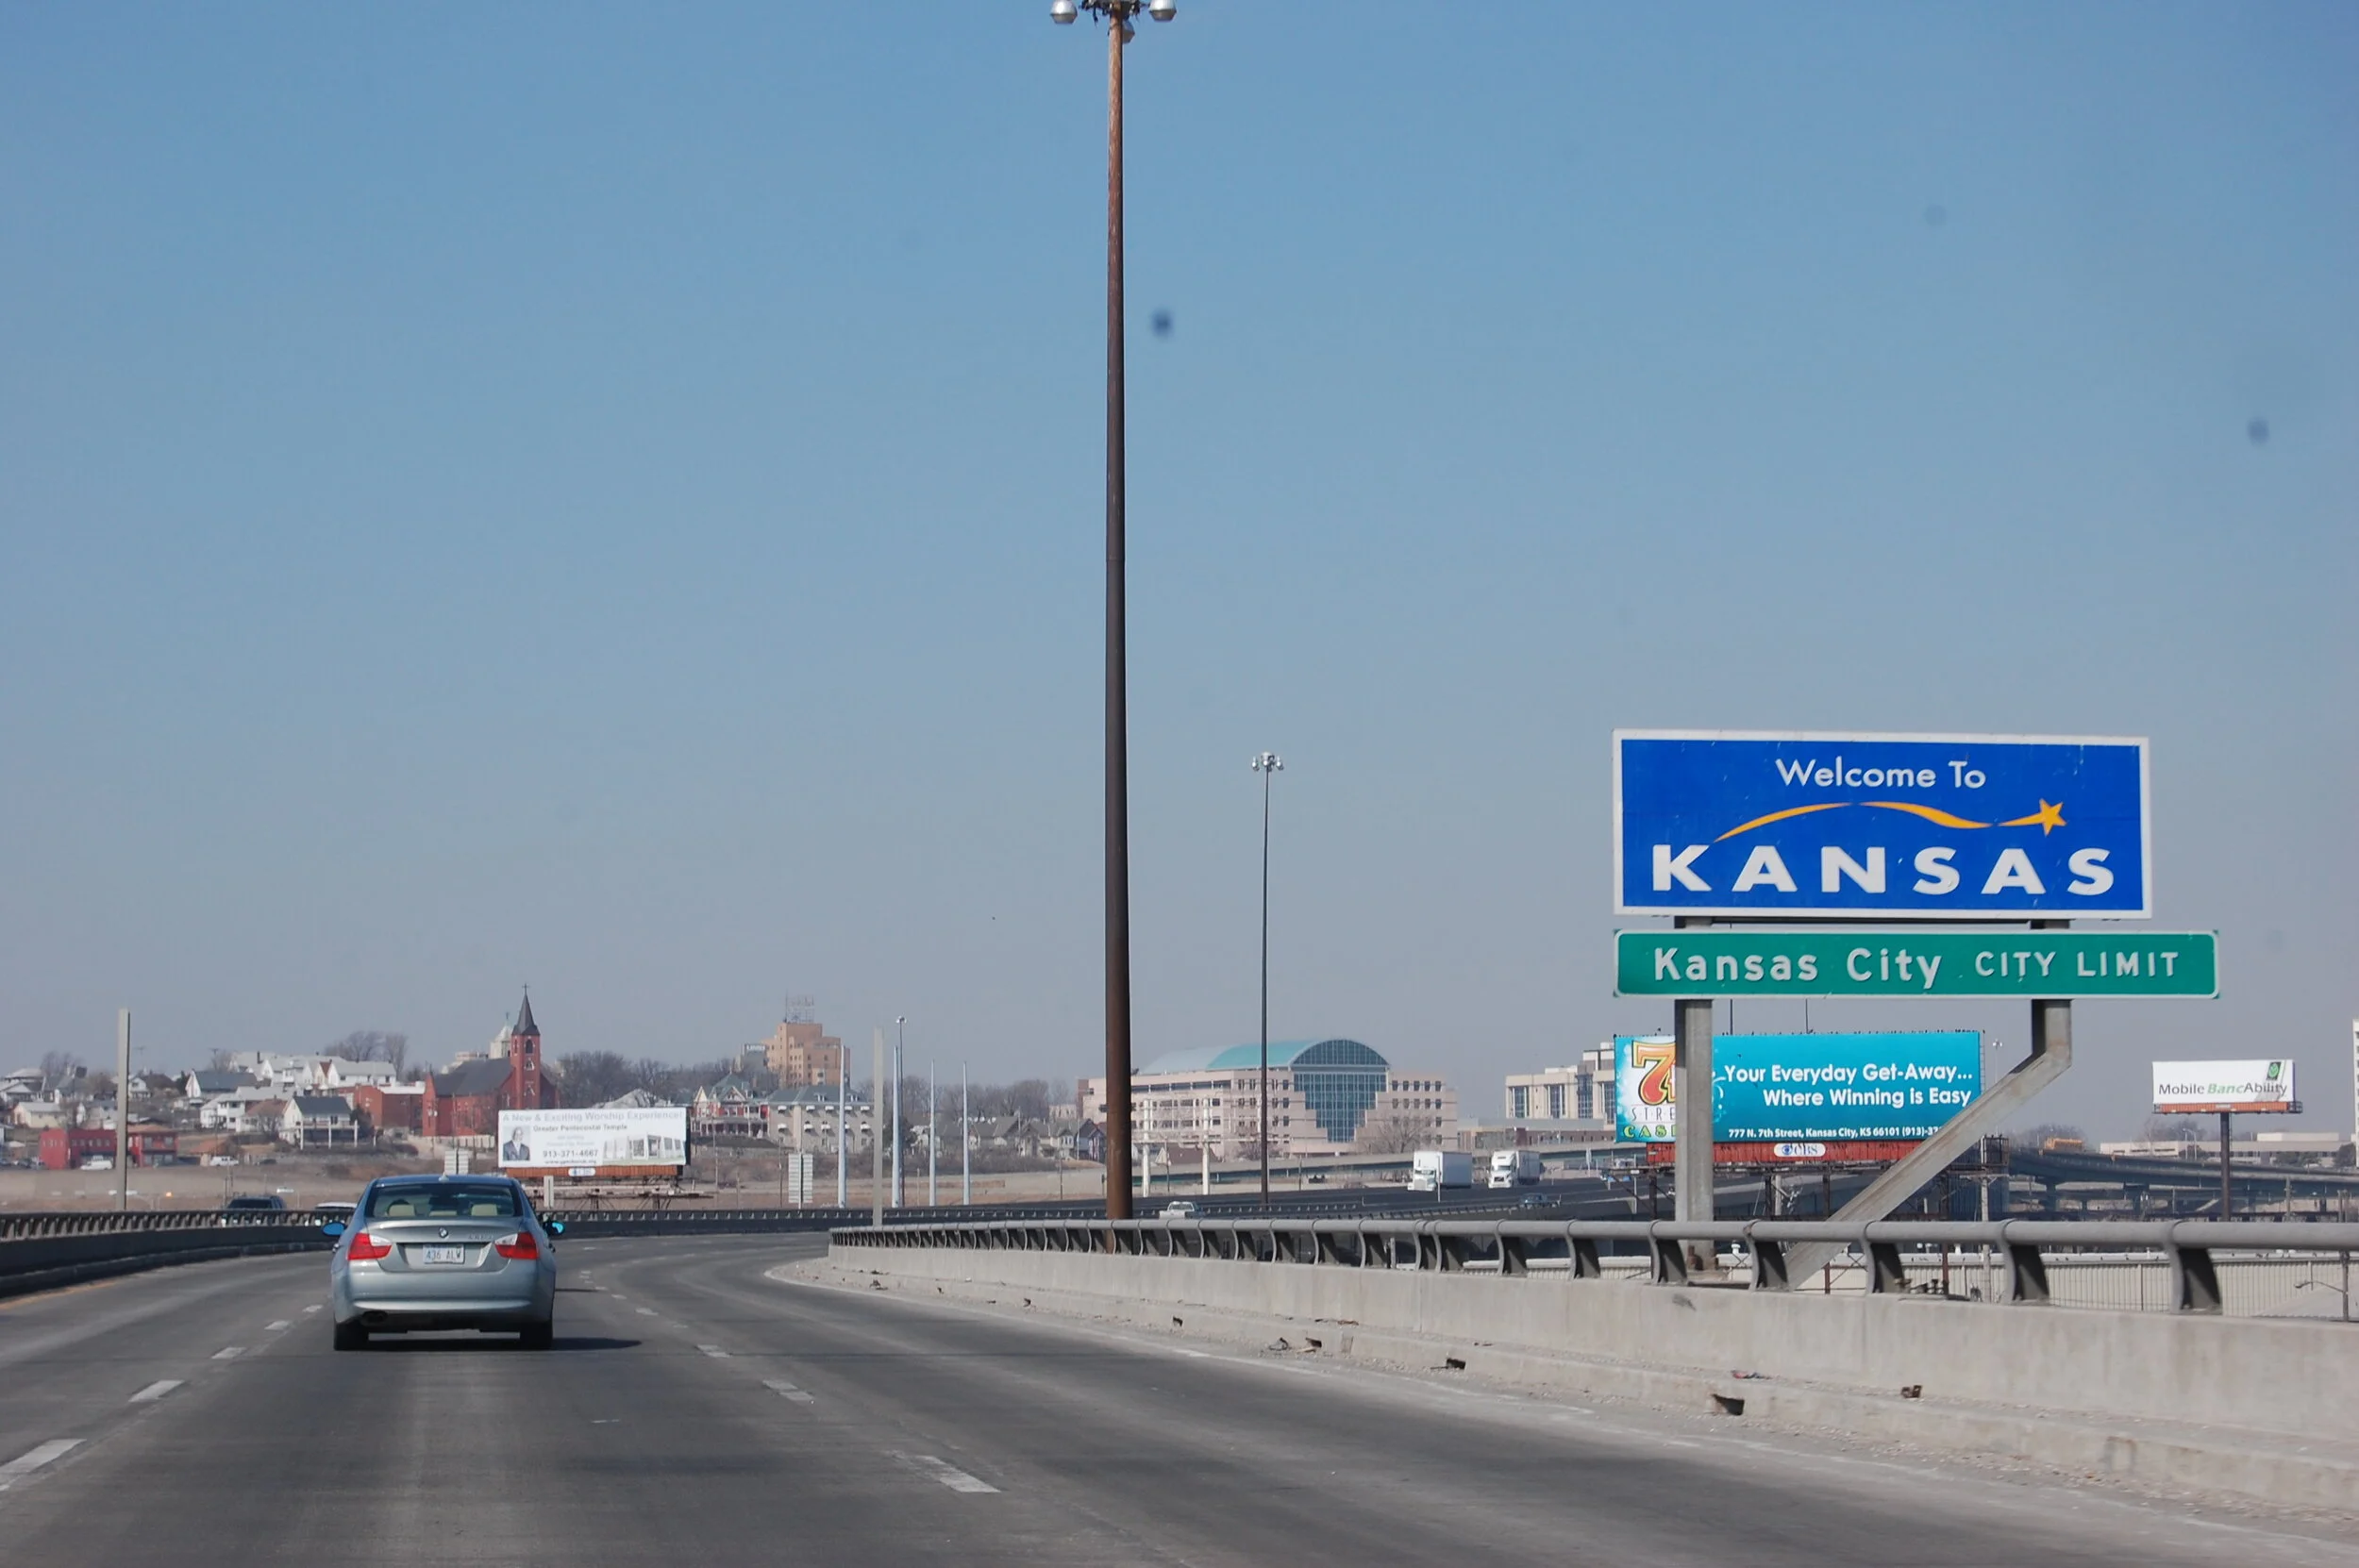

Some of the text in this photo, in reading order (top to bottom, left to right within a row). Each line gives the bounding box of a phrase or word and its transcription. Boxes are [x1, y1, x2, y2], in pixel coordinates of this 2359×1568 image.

[1775, 757, 1986, 789] Welcome To
[1651, 844, 2116, 896] KANSAS
[1654, 946, 2180, 990] Kansas City CITY LIMIT
[1724, 1062, 1973, 1086] Your Everyday Get-Away...
[1763, 1086, 1972, 1109] Where Winning is Easy
[2158, 1083, 2205, 1095] Mobile
[584, 1111, 625, 1122] Worship
[1631, 1107, 1676, 1122] STRE
[1728, 1128, 1746, 1138] 777
[1747, 1128, 1757, 1138] N.
[1758, 1127, 1774, 1138] 7th
[1775, 1127, 1804, 1139] Street,
[1805, 1127, 1837, 1138] Kansas
[1838, 1127, 1859, 1139] City,
[1860, 1126, 1872, 1137] KS
[1872, 1126, 1900, 1137] 66101
